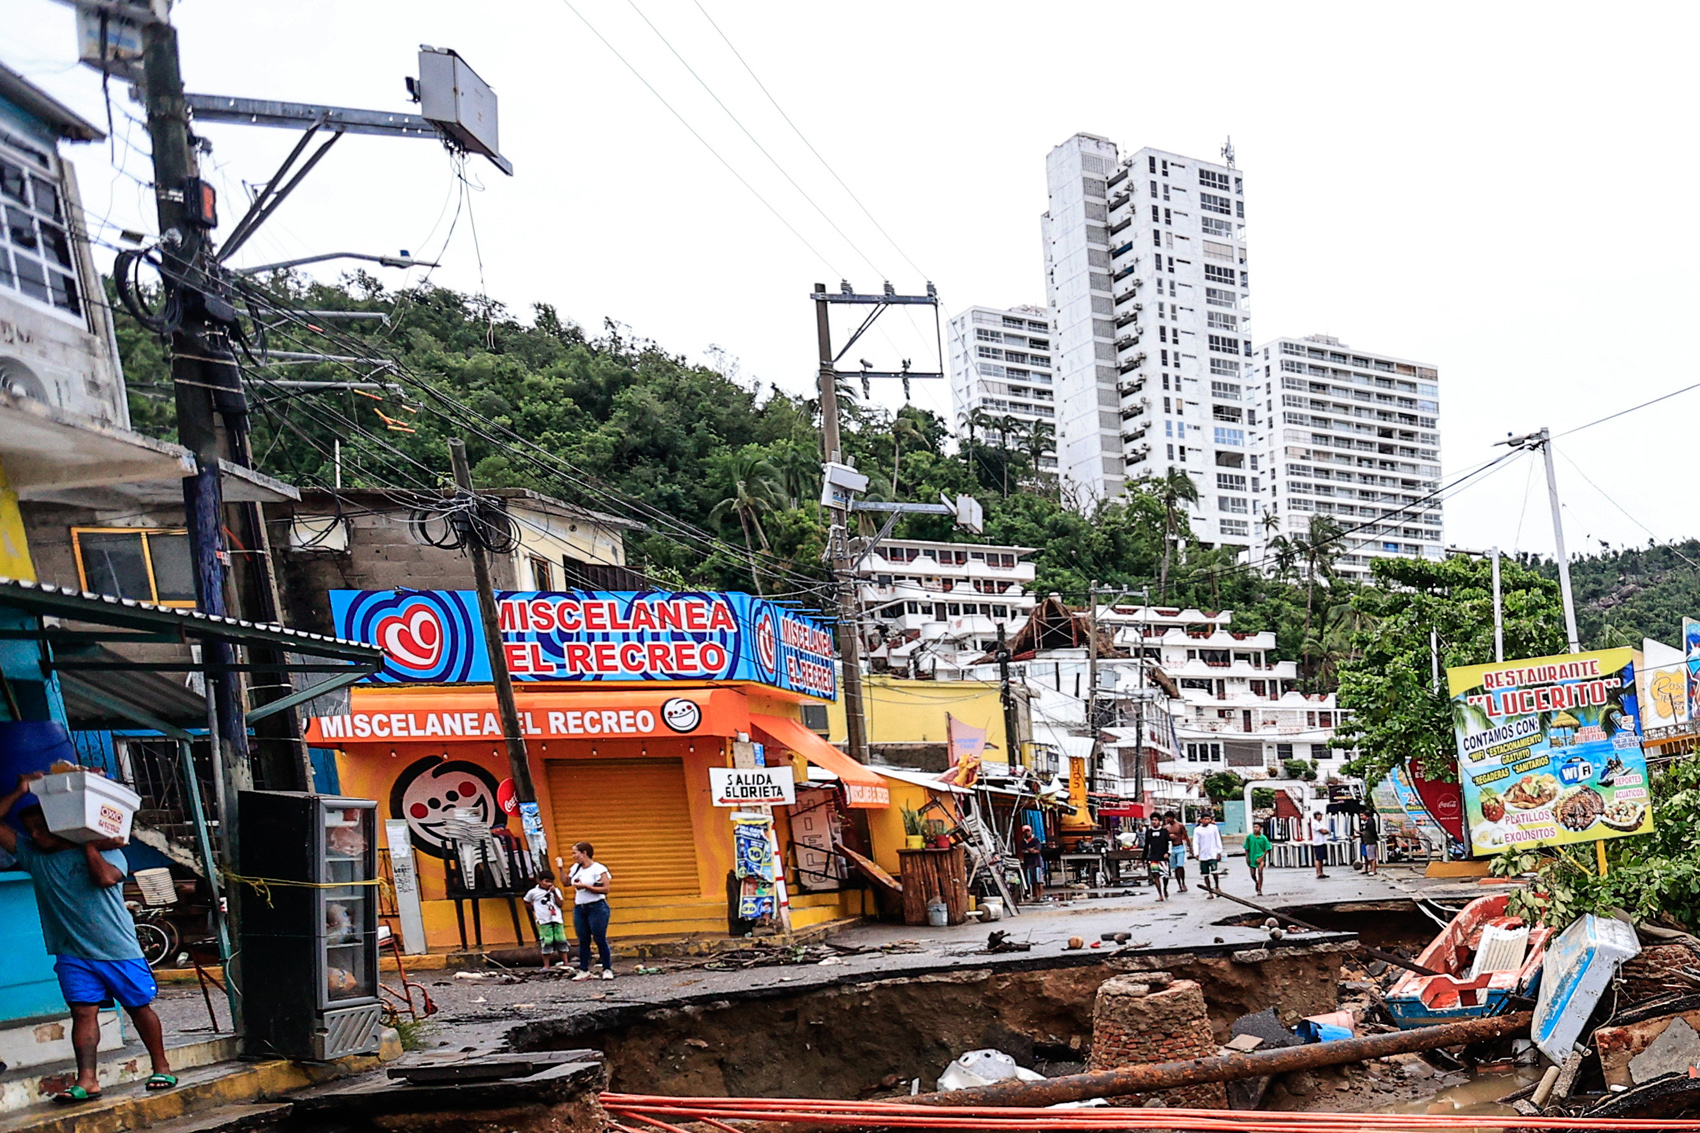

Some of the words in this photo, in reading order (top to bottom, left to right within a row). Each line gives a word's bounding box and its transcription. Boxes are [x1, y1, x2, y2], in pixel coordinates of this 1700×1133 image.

[498, 601, 737, 632] MISCELANEA
[781, 617, 834, 659] MISCELANEA
[506, 643, 556, 674] EL
[566, 642, 727, 673] RECREO
[787, 655, 801, 685] EL
[801, 660, 834, 693] RECREO
[1484, 660, 1599, 689] RESTAURANTE
[320, 711, 502, 738] MISCELANEA
[517, 713, 541, 735] EL
[548, 709, 655, 735] RECREO
[1463, 724, 1514, 751] CONTAMOS
[1516, 717, 1539, 735] CON:
[1502, 749, 1530, 764] GRATUITO
[725, 785, 784, 798] GLORIETA
[727, 774, 773, 786] SALIDA
[1615, 775, 1642, 786] DEPORTES
[1505, 811, 1550, 825] PLATILLOS
[1504, 827, 1556, 843] EXQUISITOS
